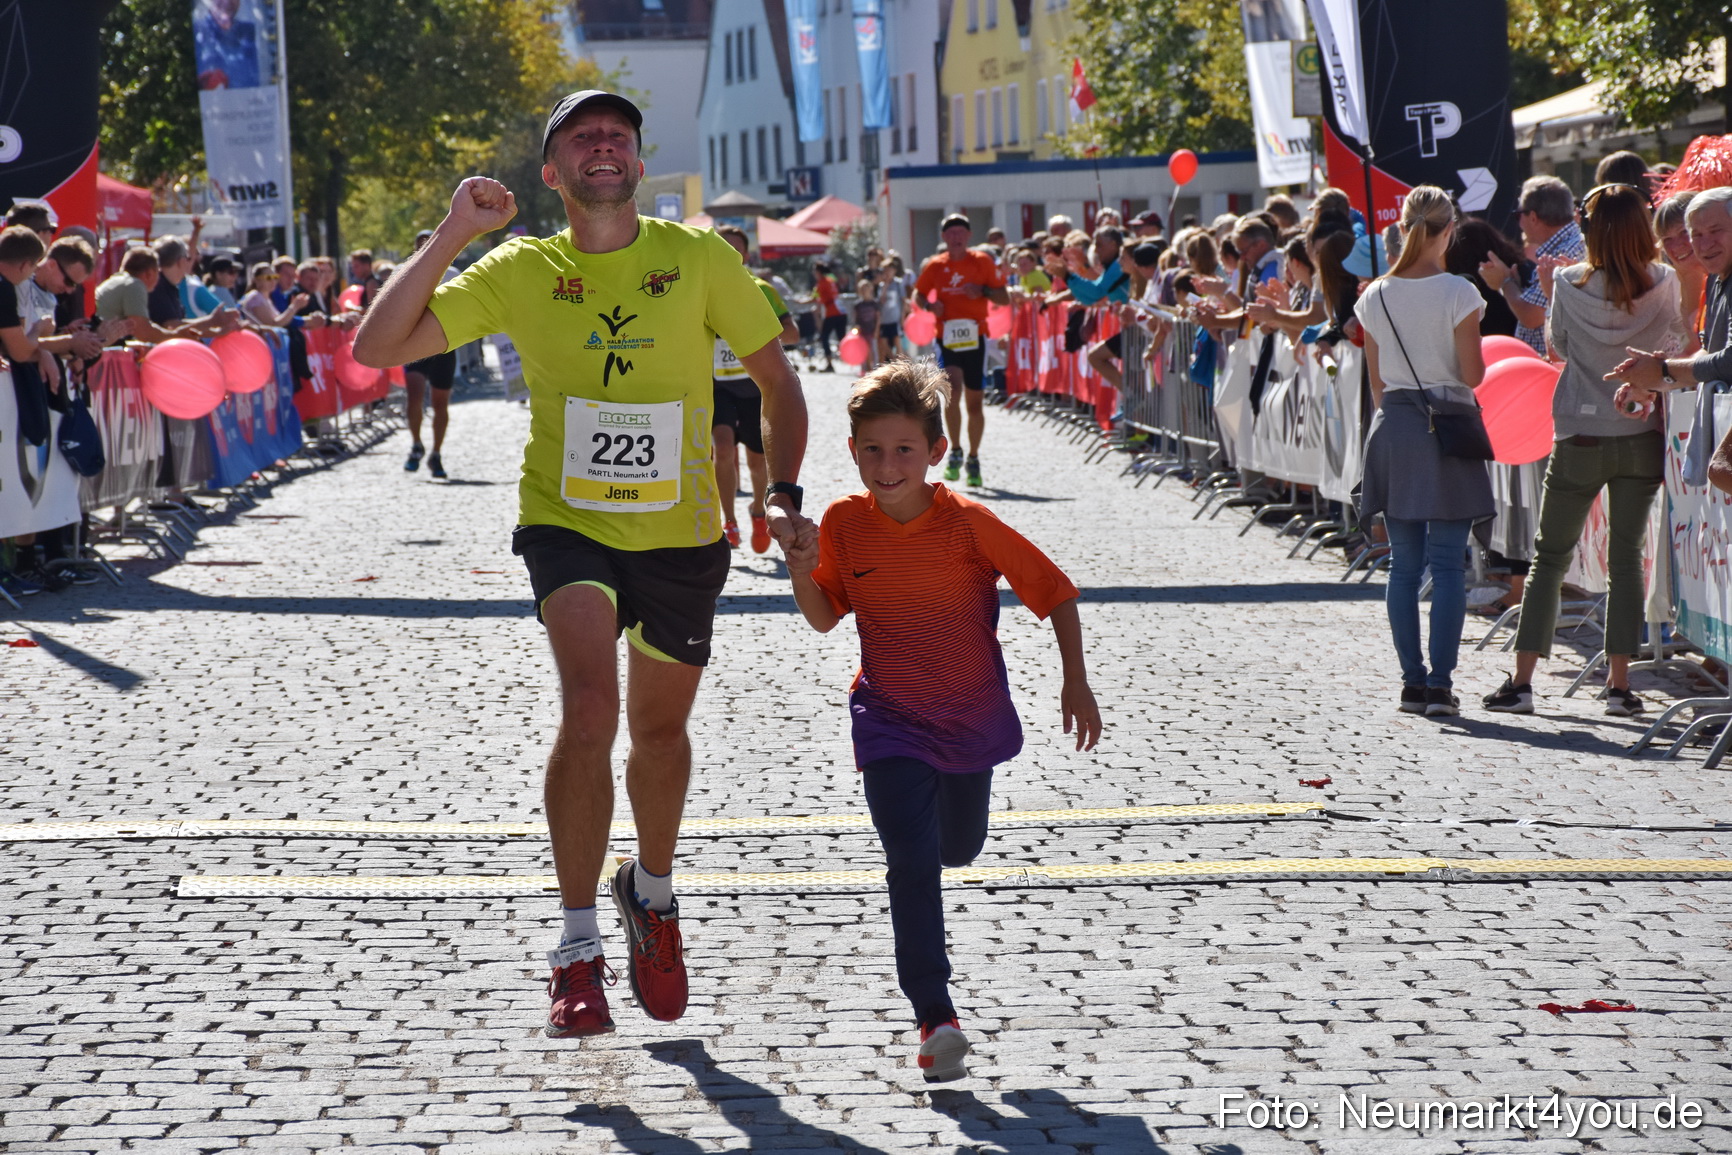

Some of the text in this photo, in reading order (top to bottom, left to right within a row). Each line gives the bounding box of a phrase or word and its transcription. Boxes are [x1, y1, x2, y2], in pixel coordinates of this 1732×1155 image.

[1376, 209, 1398, 221] 100
[554, 275, 584, 295] 15
[552, 290, 585, 304] 2015
[951, 328, 971, 339] 100
[598, 411, 652, 426] BOCK
[591, 432, 656, 467] 223
[587, 468, 649, 479] PARTL Neumarkt
[605, 485, 639, 500] Jens
